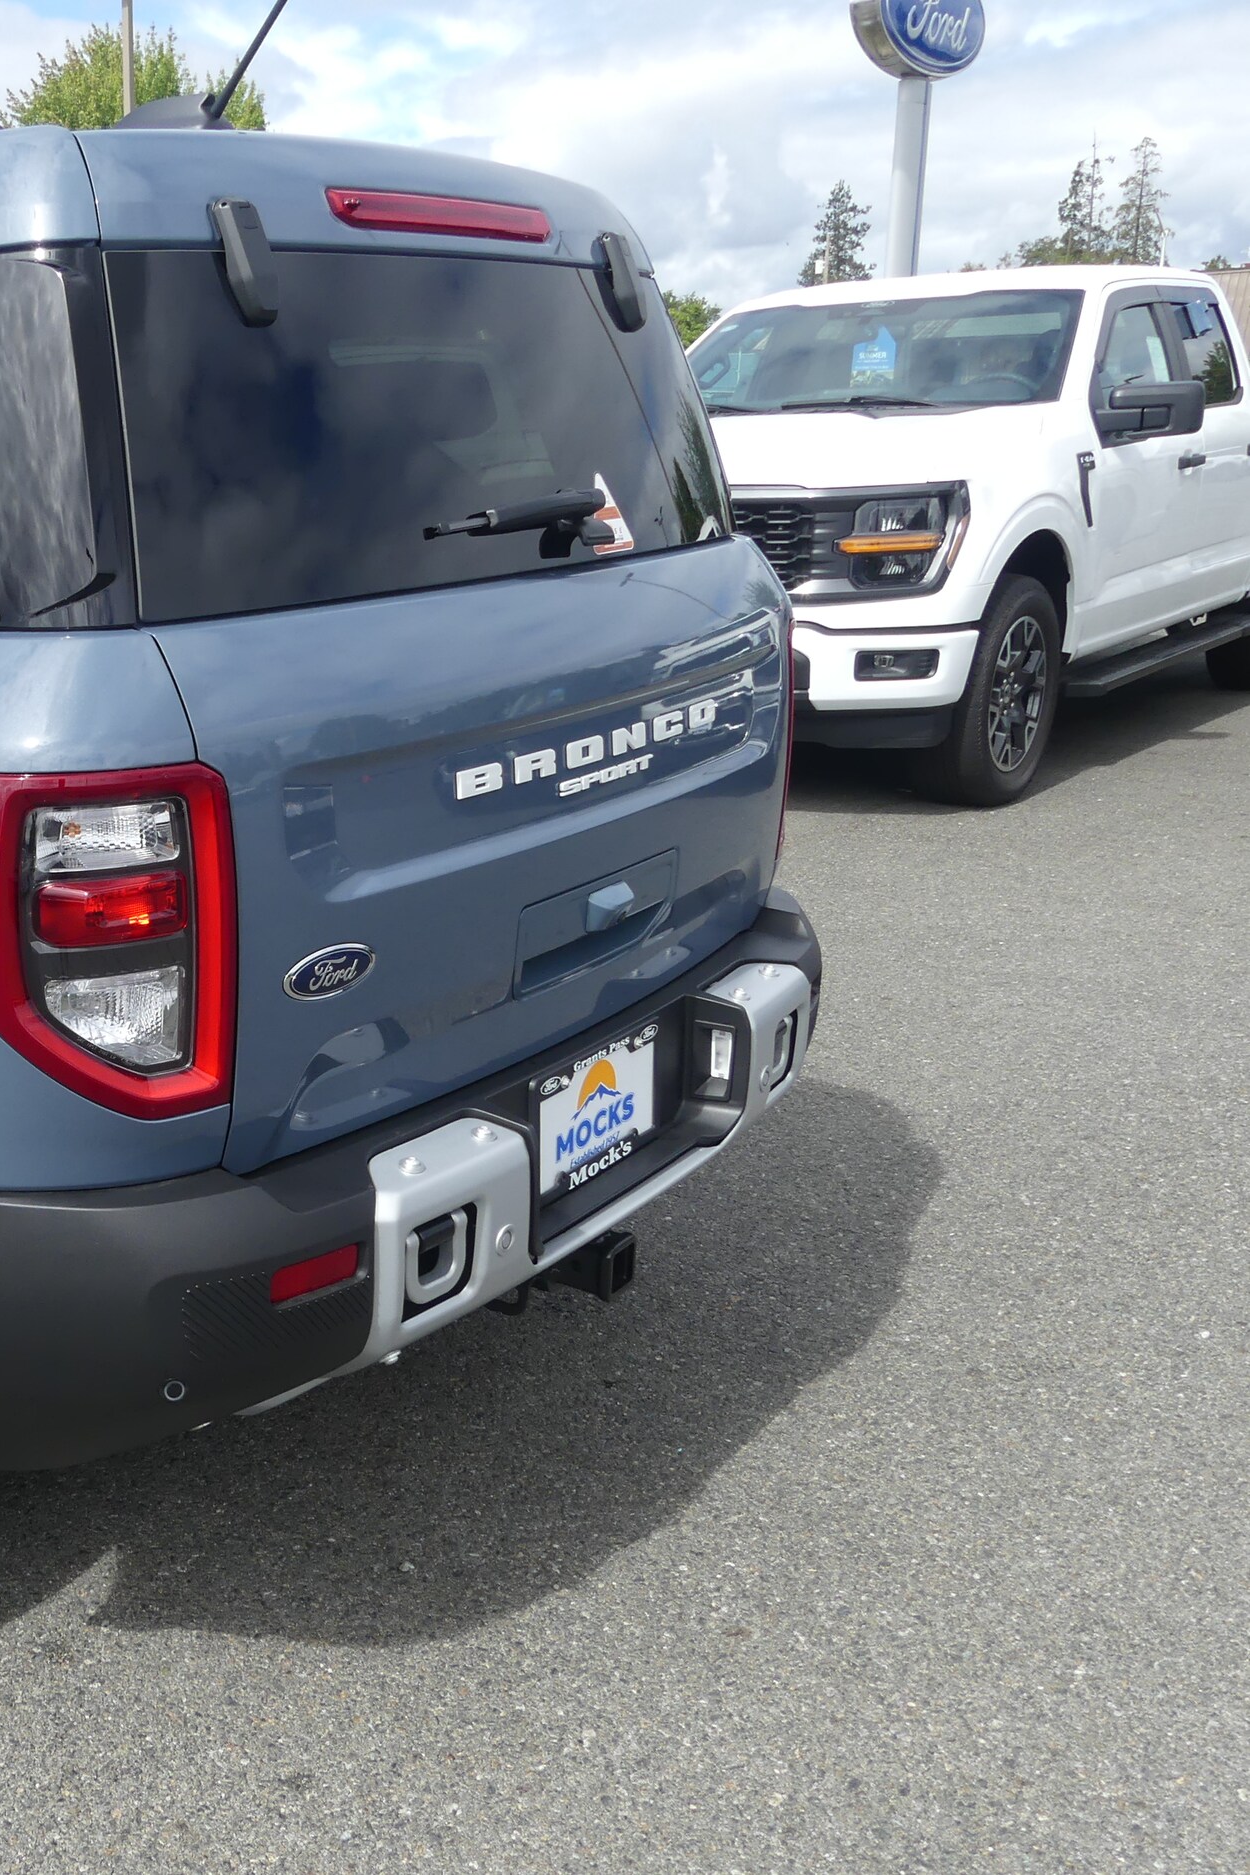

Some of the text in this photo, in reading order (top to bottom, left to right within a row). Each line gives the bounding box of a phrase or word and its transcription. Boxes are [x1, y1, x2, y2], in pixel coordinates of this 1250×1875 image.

[455, 699, 716, 800] BRONCO
[558, 754, 654, 797] SPORT
[309, 956, 358, 991] Ford
[573, 1036, 630, 1073] Grants Pass
[555, 1092, 634, 1162] MOCKS
[568, 1140, 633, 1190] Mock's
